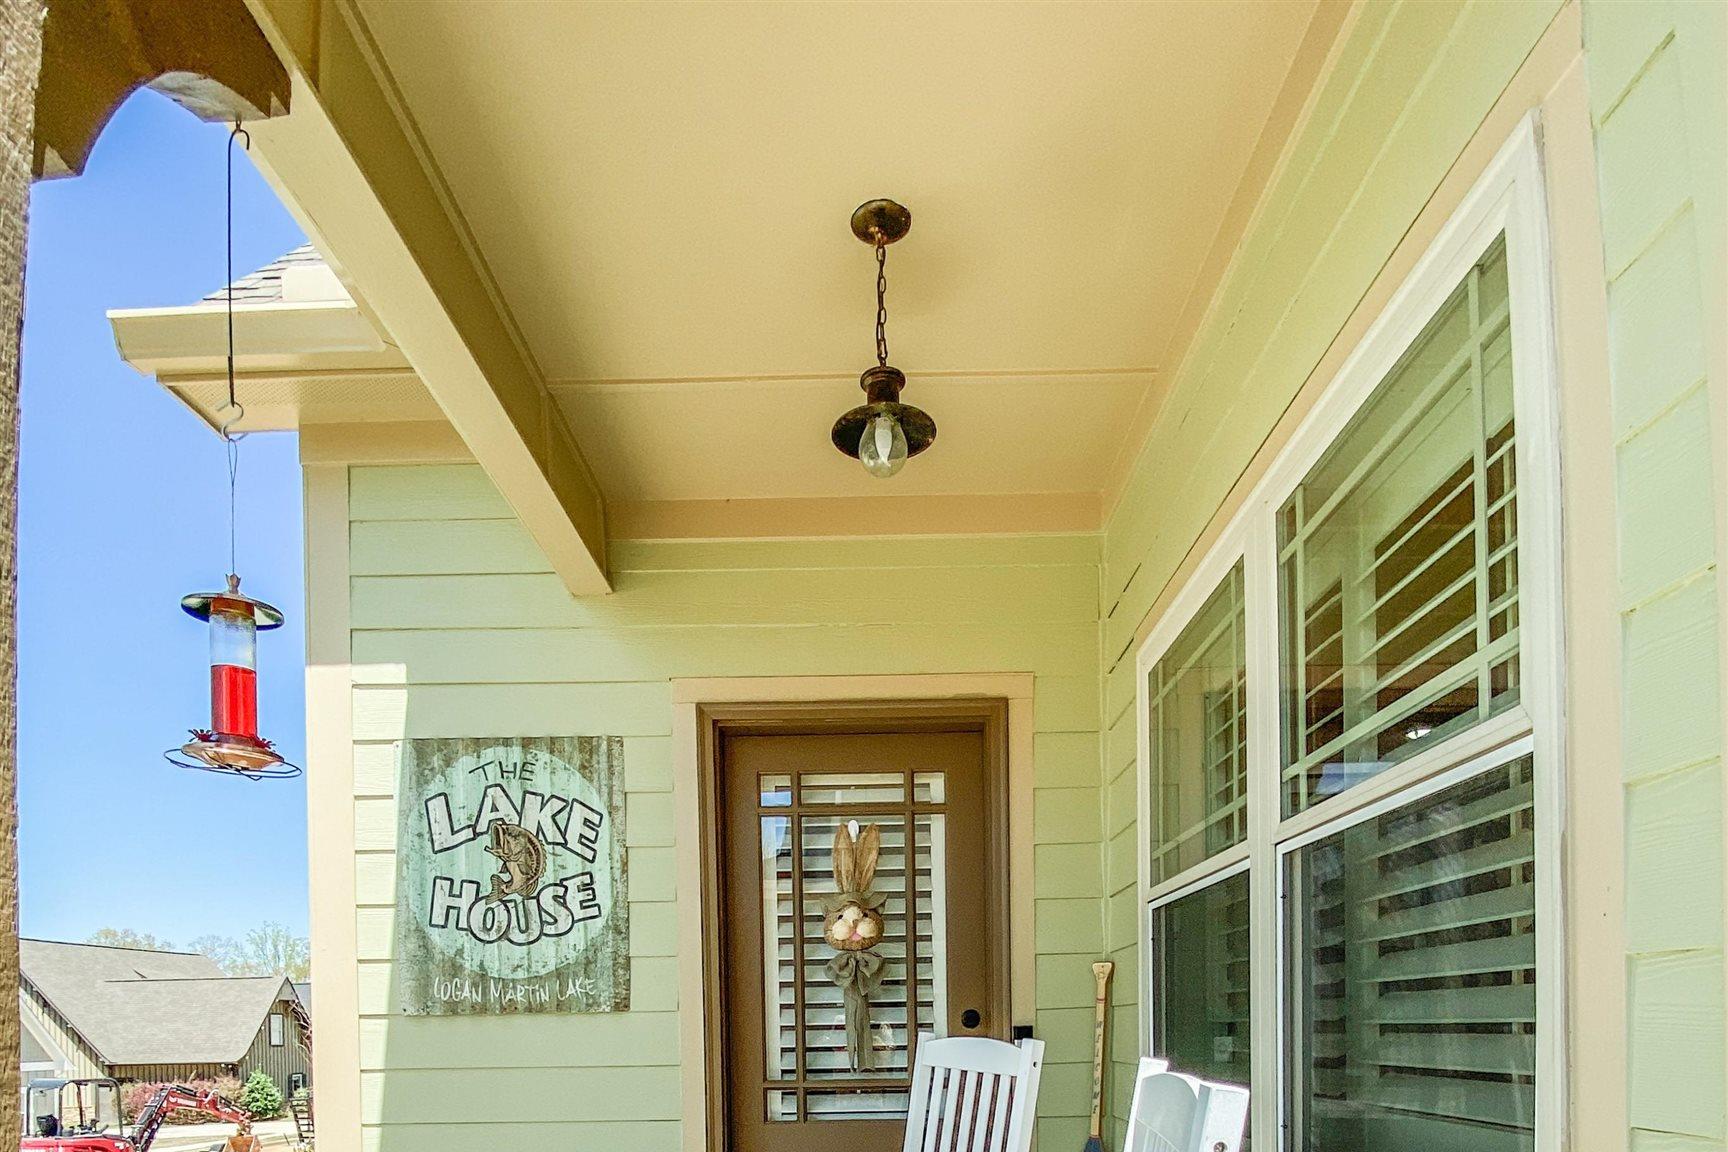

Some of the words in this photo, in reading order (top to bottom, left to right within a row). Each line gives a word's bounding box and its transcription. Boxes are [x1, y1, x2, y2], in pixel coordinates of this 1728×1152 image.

[468, 760, 536, 782] THE
[424, 783, 604, 864] LAKE
[429, 871, 602, 947] HOUSE
[433, 976, 482, 1002] LOGAN
[490, 978, 550, 1005] MARTIN
[556, 976, 597, 1000] LAKE
